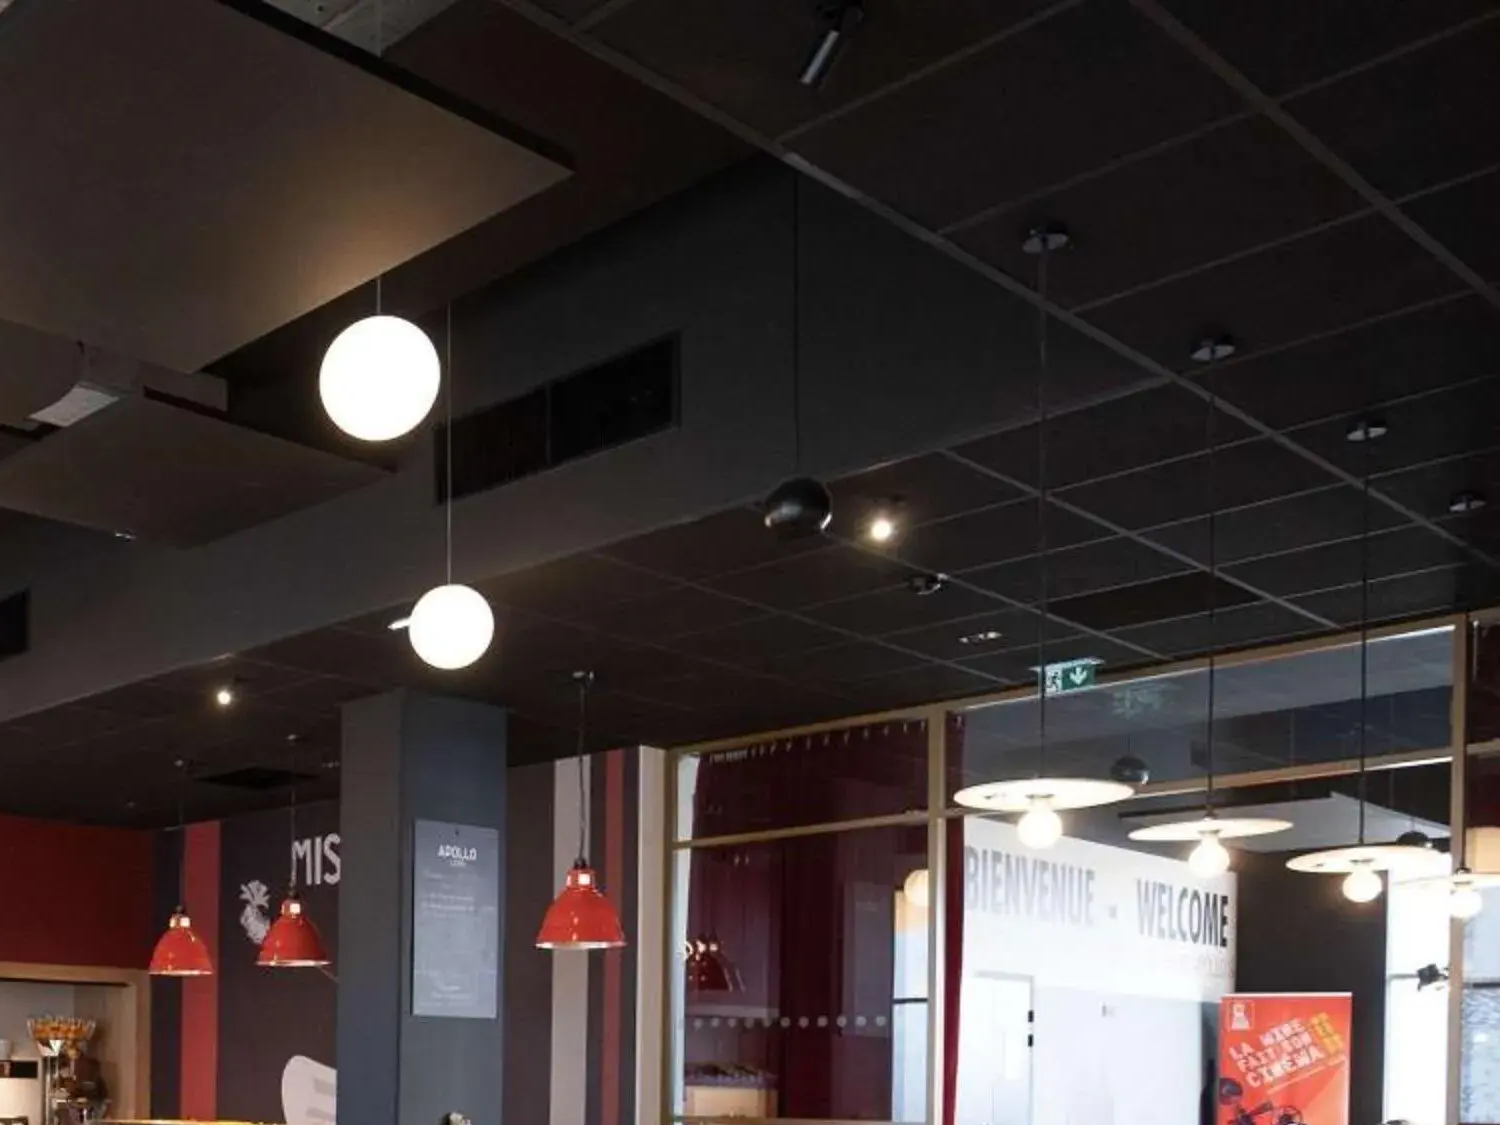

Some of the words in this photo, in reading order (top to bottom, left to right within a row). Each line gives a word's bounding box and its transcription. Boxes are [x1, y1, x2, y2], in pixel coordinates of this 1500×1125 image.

[291, 833, 341, 885] MIS
[437, 844, 477, 861] APOLLO
[964, 846, 1095, 926] BIENVENUE
[1136, 878, 1228, 948] WELCOME
